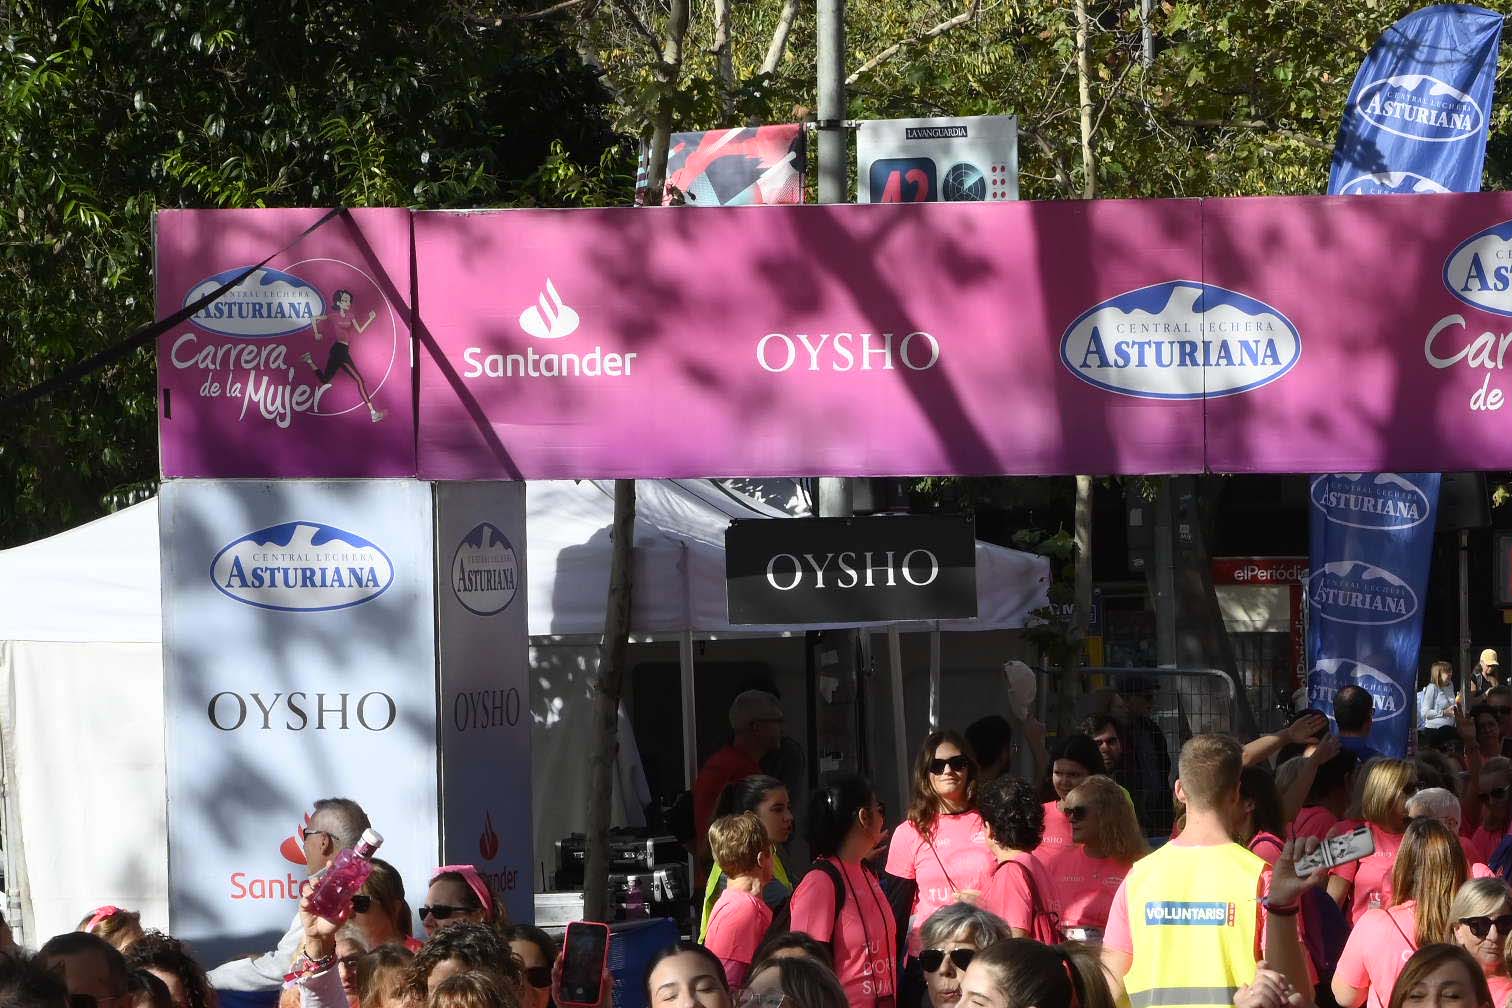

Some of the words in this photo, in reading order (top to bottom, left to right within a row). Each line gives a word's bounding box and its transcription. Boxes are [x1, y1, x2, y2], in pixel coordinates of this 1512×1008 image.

[1365, 91, 1473, 131] ASTURIANA
[1116, 322, 1191, 333] CENTRAL
[170, 332, 289, 370] Carrera
[463, 345, 637, 378] Santander
[756, 331, 940, 373] OYSHO
[1080, 325, 1282, 370] ASTURIANA
[200, 372, 222, 397] de
[226, 371, 242, 397] la
[239, 365, 333, 429] Mujer
[1469, 373, 1505, 412] de
[1319, 481, 1420, 521] ASTURIANA
[225, 555, 381, 590] ASTURIANA
[252, 552, 311, 562] CENTRAL
[316, 552, 375, 562] LECHERA
[457, 557, 515, 594] ASTURIANA
[766, 548, 940, 592] OYSHO
[207, 690, 397, 732] OYSHO
[454, 686, 521, 733] OYSHO
[1146, 906, 1225, 921] VOLUNTARIS
